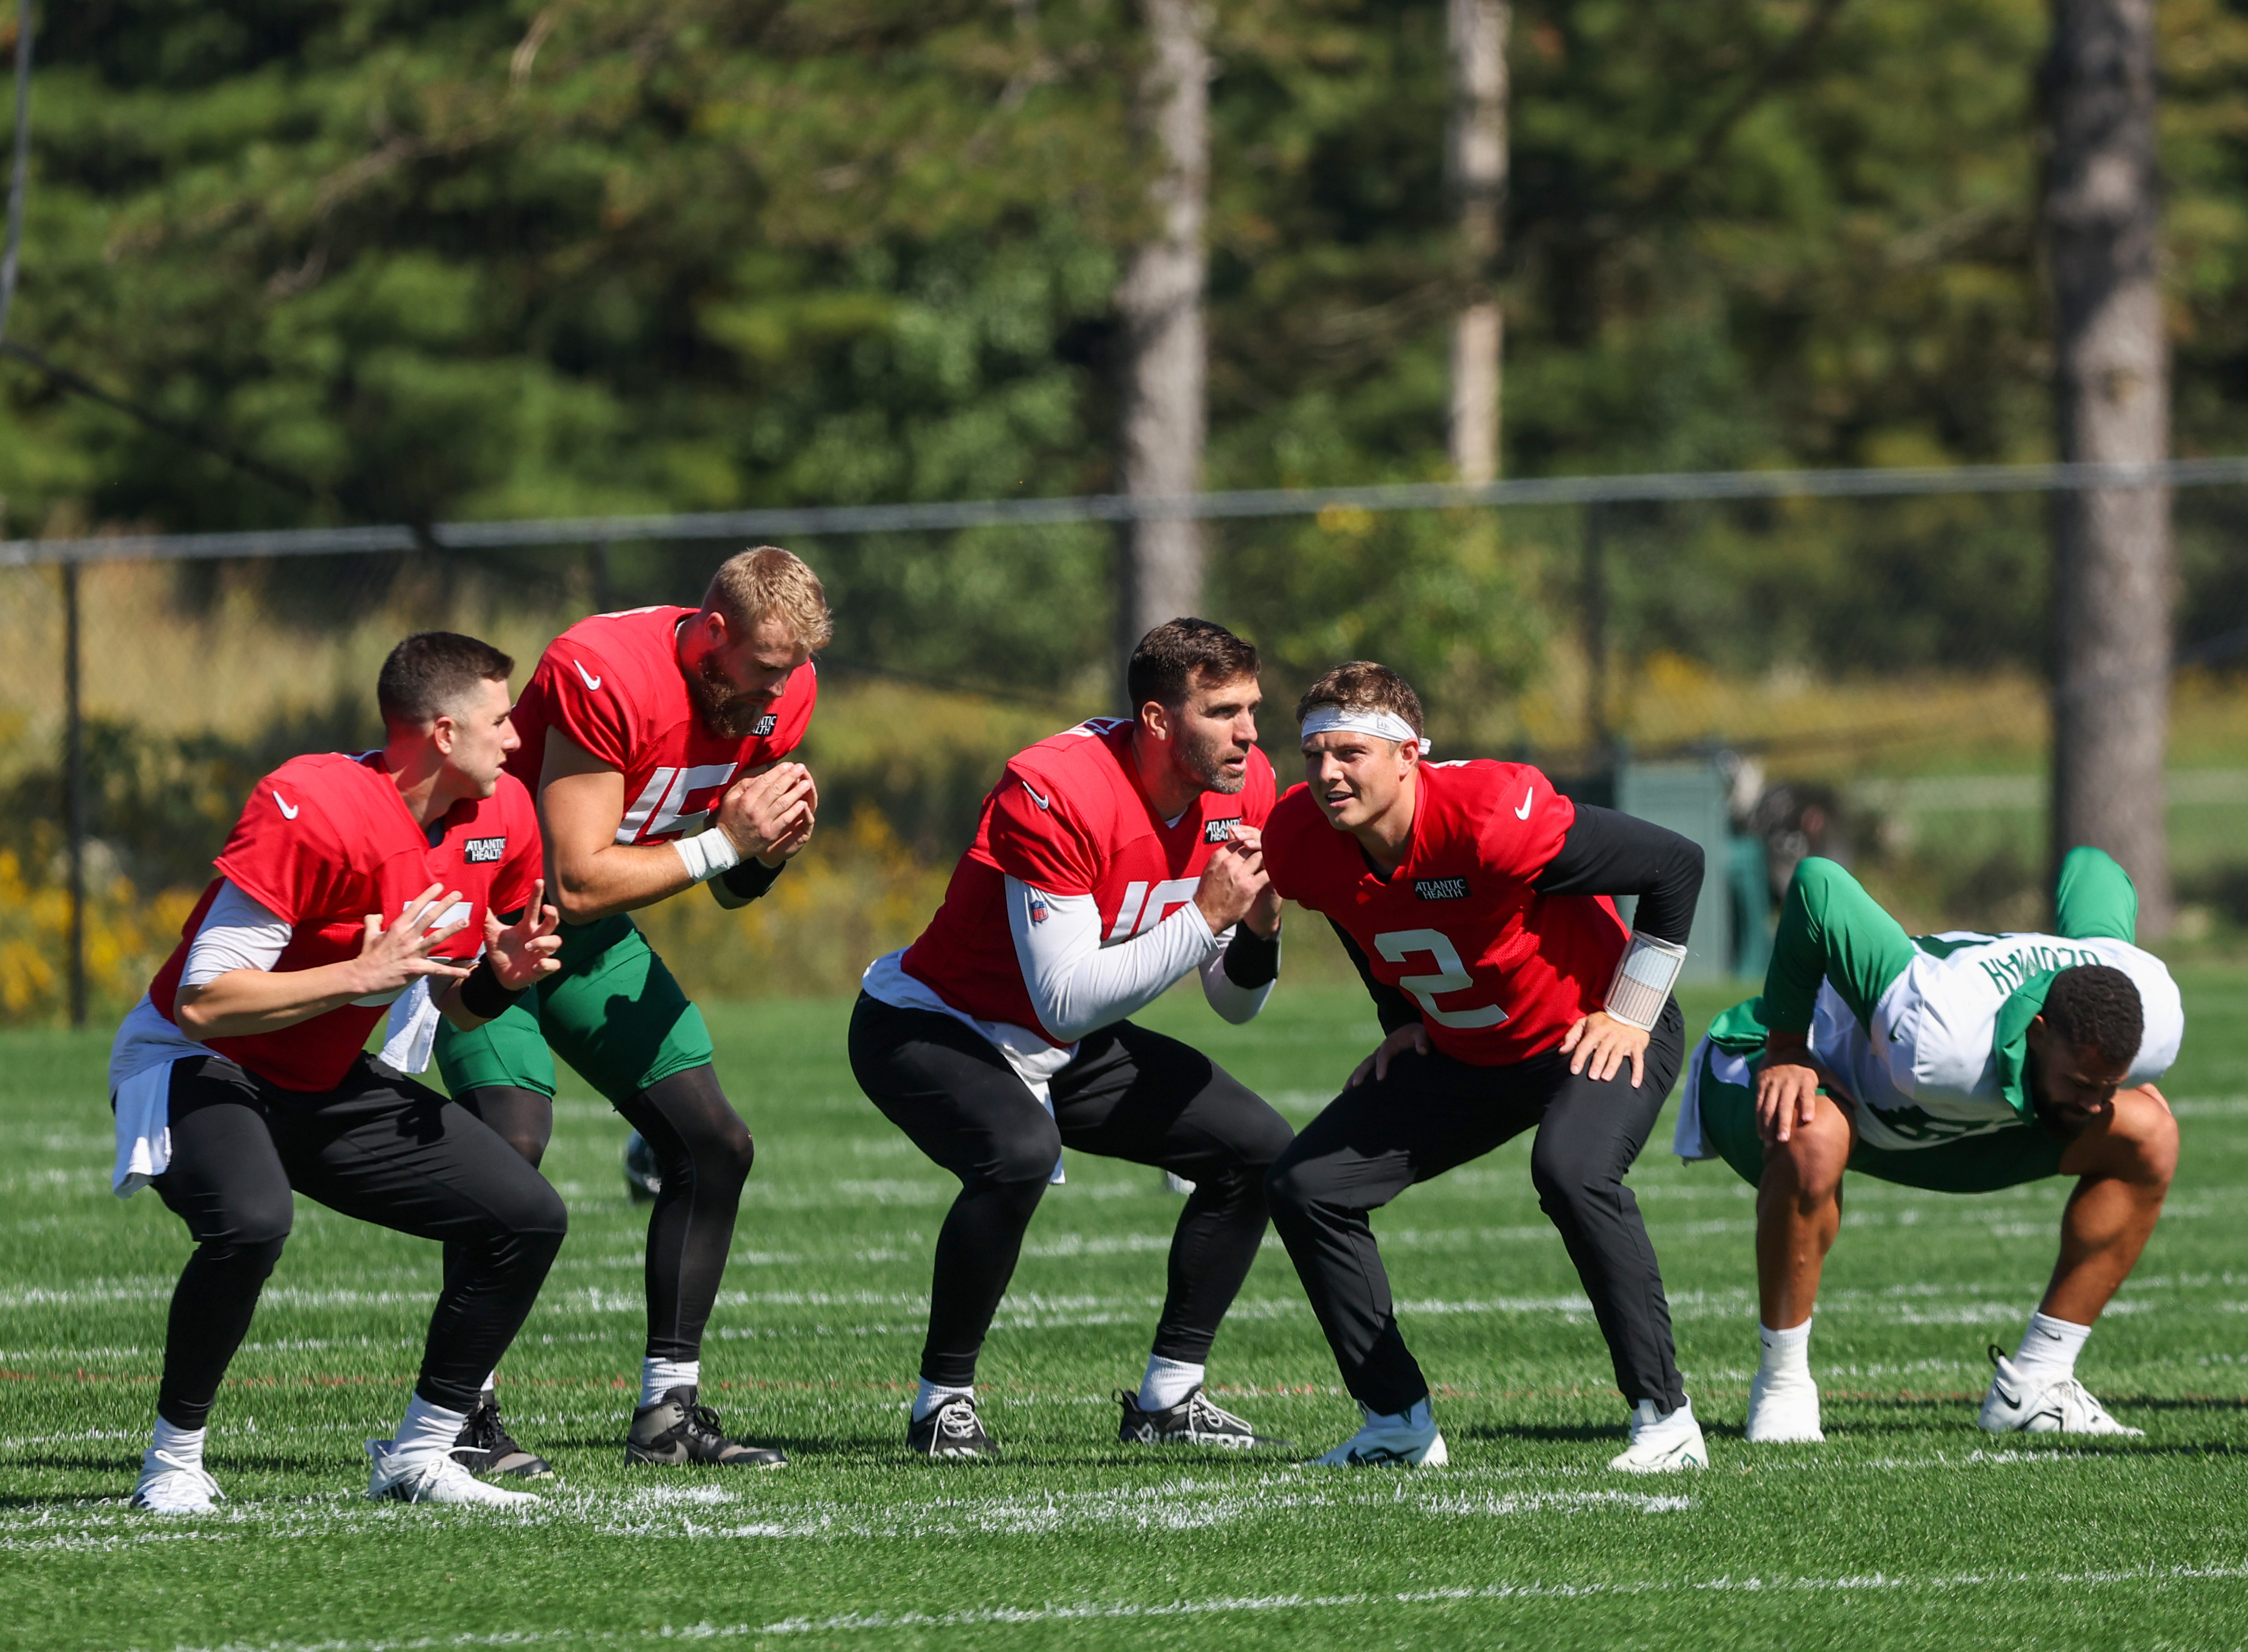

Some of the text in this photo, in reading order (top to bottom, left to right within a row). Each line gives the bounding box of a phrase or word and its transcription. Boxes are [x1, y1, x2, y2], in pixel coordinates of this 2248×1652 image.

[756, 716, 777, 726] NTIC
[1209, 830, 1229, 842] HEA
[464, 838, 506, 852] ATLANTIC
[1415, 878, 1466, 892] ATLANTIC
[1423, 889, 1464, 899] HEALTH
[1373, 928, 1510, 1029] 2
